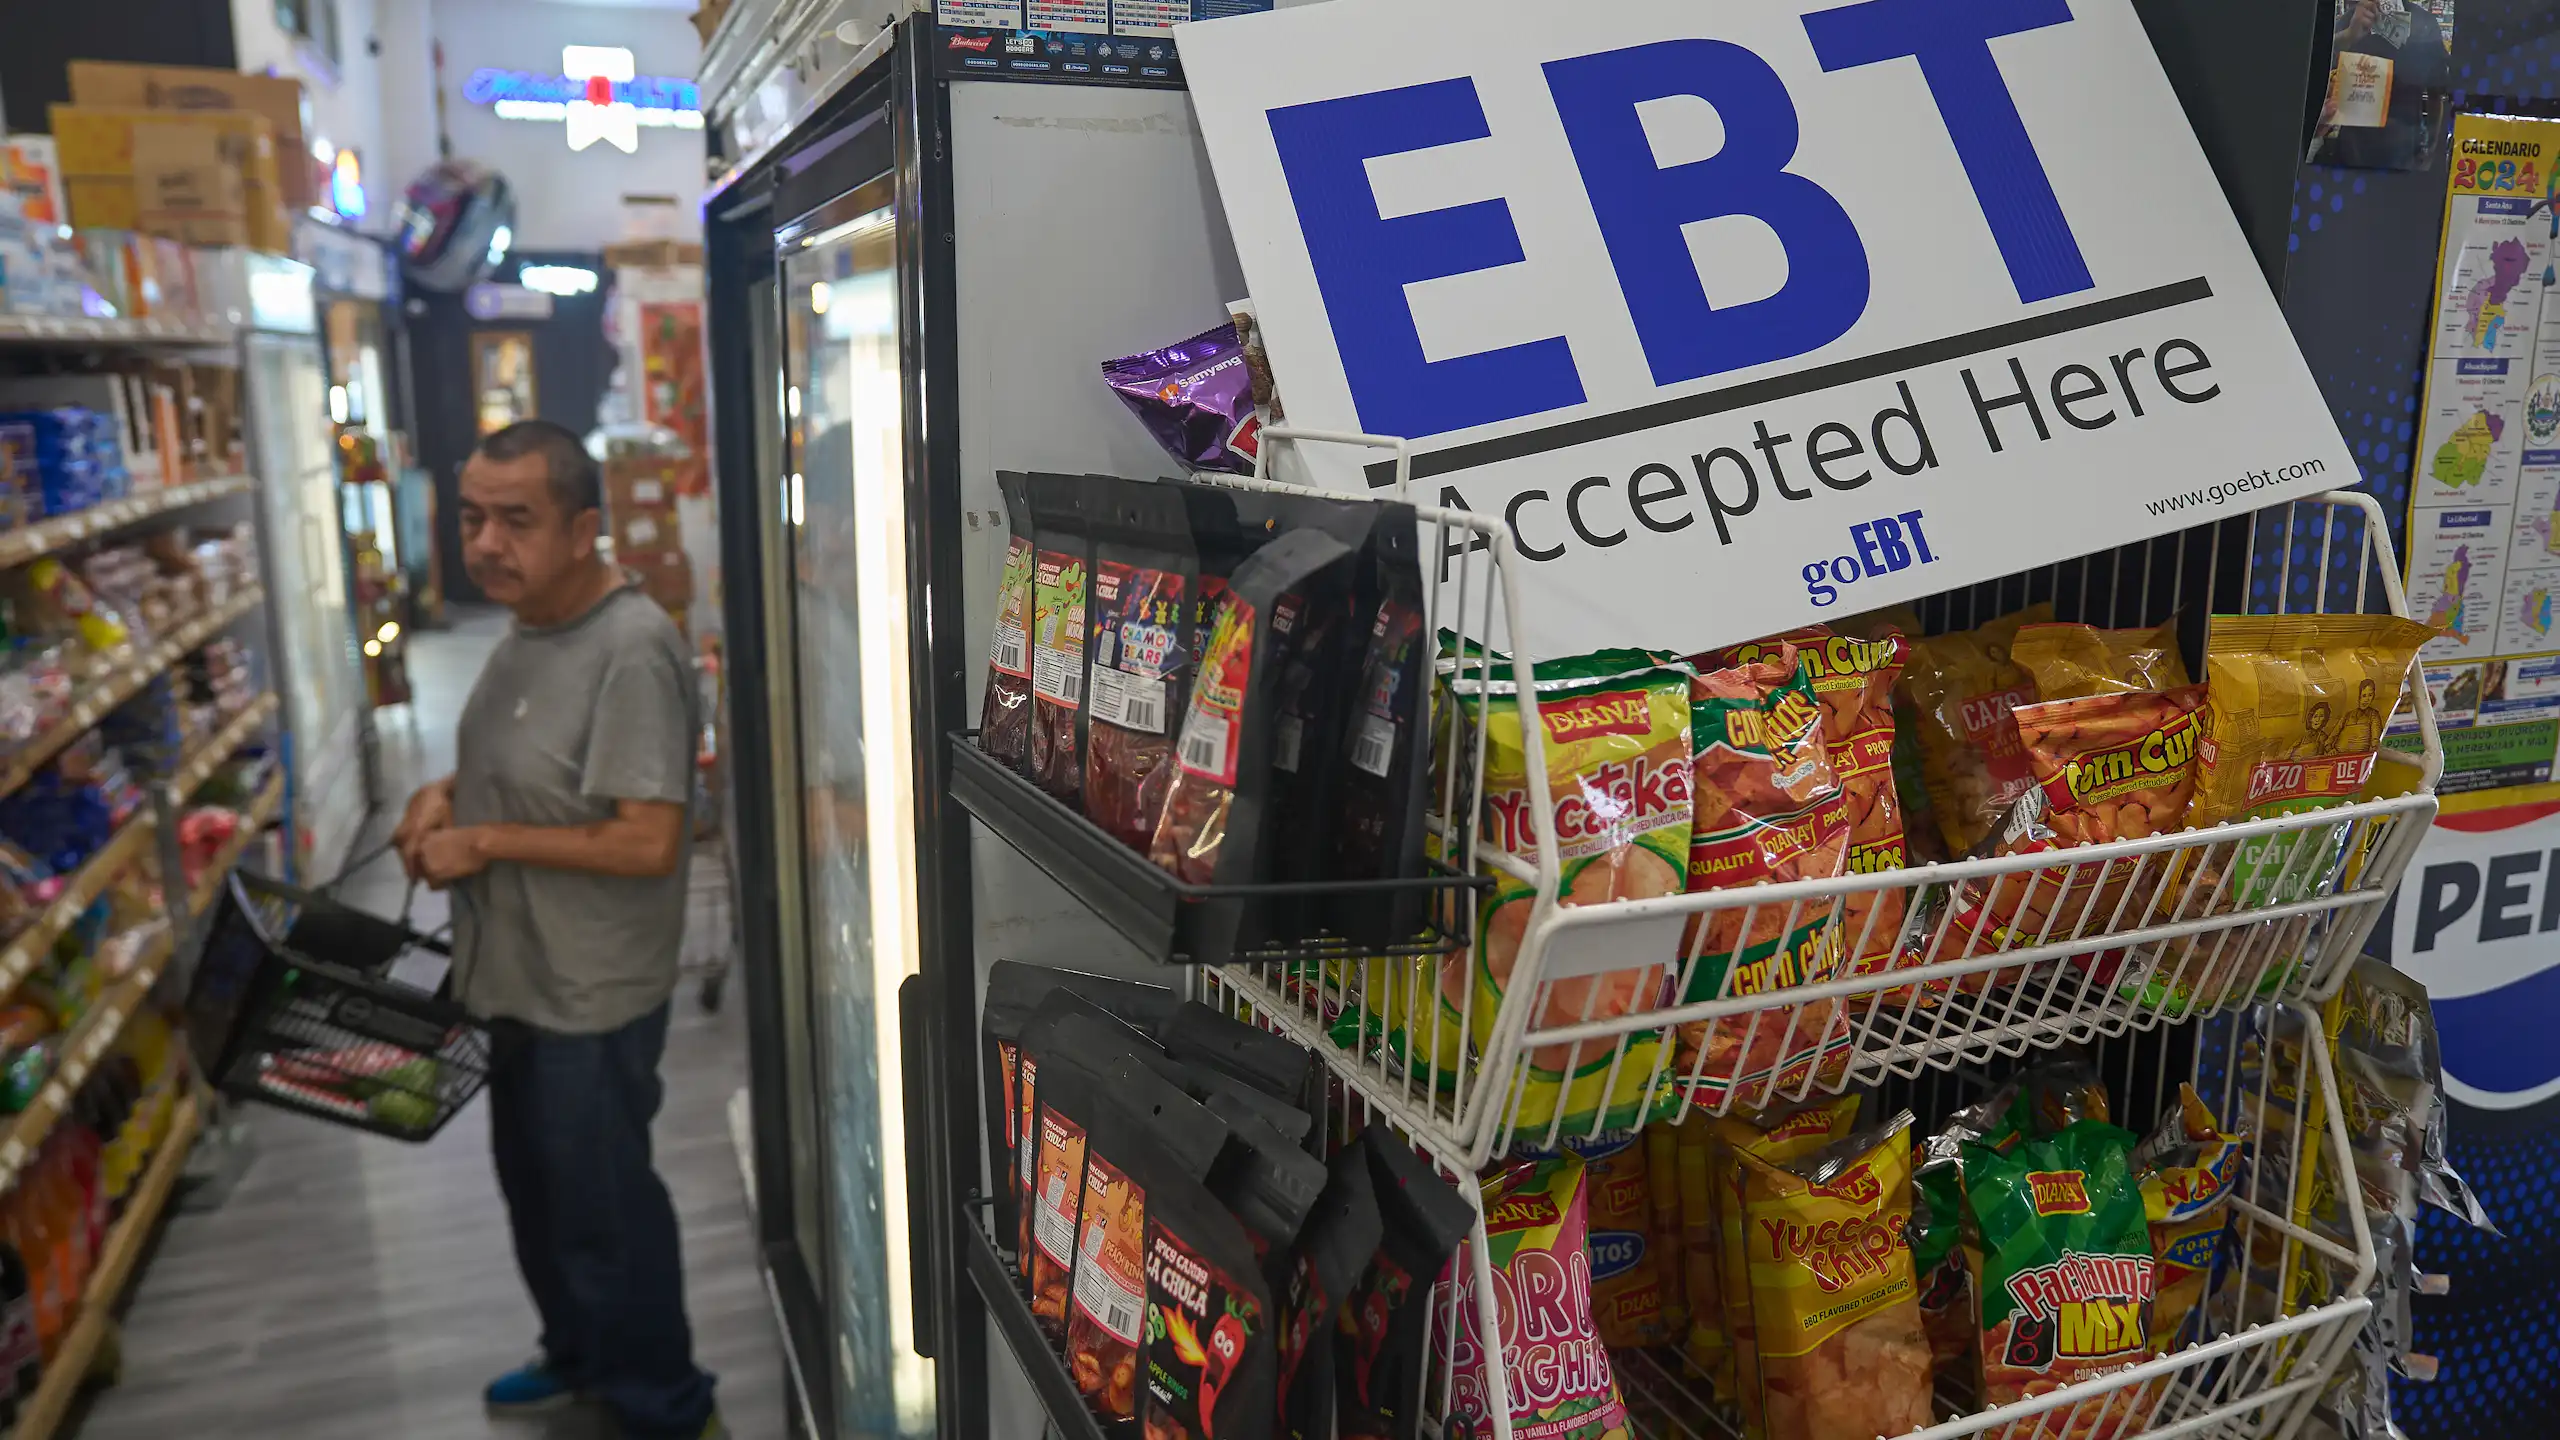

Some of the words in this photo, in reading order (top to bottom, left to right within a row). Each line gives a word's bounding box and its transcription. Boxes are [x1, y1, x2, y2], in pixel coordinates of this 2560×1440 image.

[951, 36, 989, 48] Budweiser
[1005, 45, 1034, 53] DODGERS
[2462, 140, 2540, 157] CALENDARIO
[2454, 158, 2540, 194] 2024
[1265, 0, 2095, 441] EBT
[1440, 381, 1939, 584] Accepted
[1960, 338, 2221, 454] Here
[2146, 459, 2326, 516] www.goebt.com
[1121, 627, 1175, 648] CHAMOY
[1123, 644, 1163, 665] BEARS
[1737, 643, 1825, 679] Con
[1548, 700, 1645, 733] DIANA
[1961, 691, 2021, 732] CAZO
[2089, 791, 2111, 805] Cheese
[2111, 782, 2138, 798] Covered
[2138, 775, 2168, 791] Extruded
[2169, 768, 2187, 787] Snack
[2249, 765, 2302, 800] CAZO
[2336, 760, 2356, 780] DE
[1690, 849, 1755, 875] QUALITY
[1765, 826, 1810, 854] DIANA
[1045, 1129, 1068, 1152] CHULA
[1087, 1173, 1108, 1198] CHULA
[2036, 1183, 2081, 1205] DIANA
[1485, 1199, 1555, 1226] ANA
[1760, 1209, 1880, 1262] Yucc
[1105, 1239, 1125, 1267] PEACH
[1176, 1252, 1209, 1284] CANDY
[1147, 1251, 1160, 1283] LA
[1161, 1267, 1207, 1318] CHULA
[2006, 1250, 2155, 1323] Pachanga
[1804, 1312, 1819, 1329] BBQ
[1819, 1301, 1860, 1321] FLAVORED
[1861, 1288, 1886, 1304] YUCCA
[1887, 1278, 1909, 1294] CHIPS
[1525, 1420, 1559, 1437] VANILLA
[1558, 1412, 1589, 1433] FLAVORED
